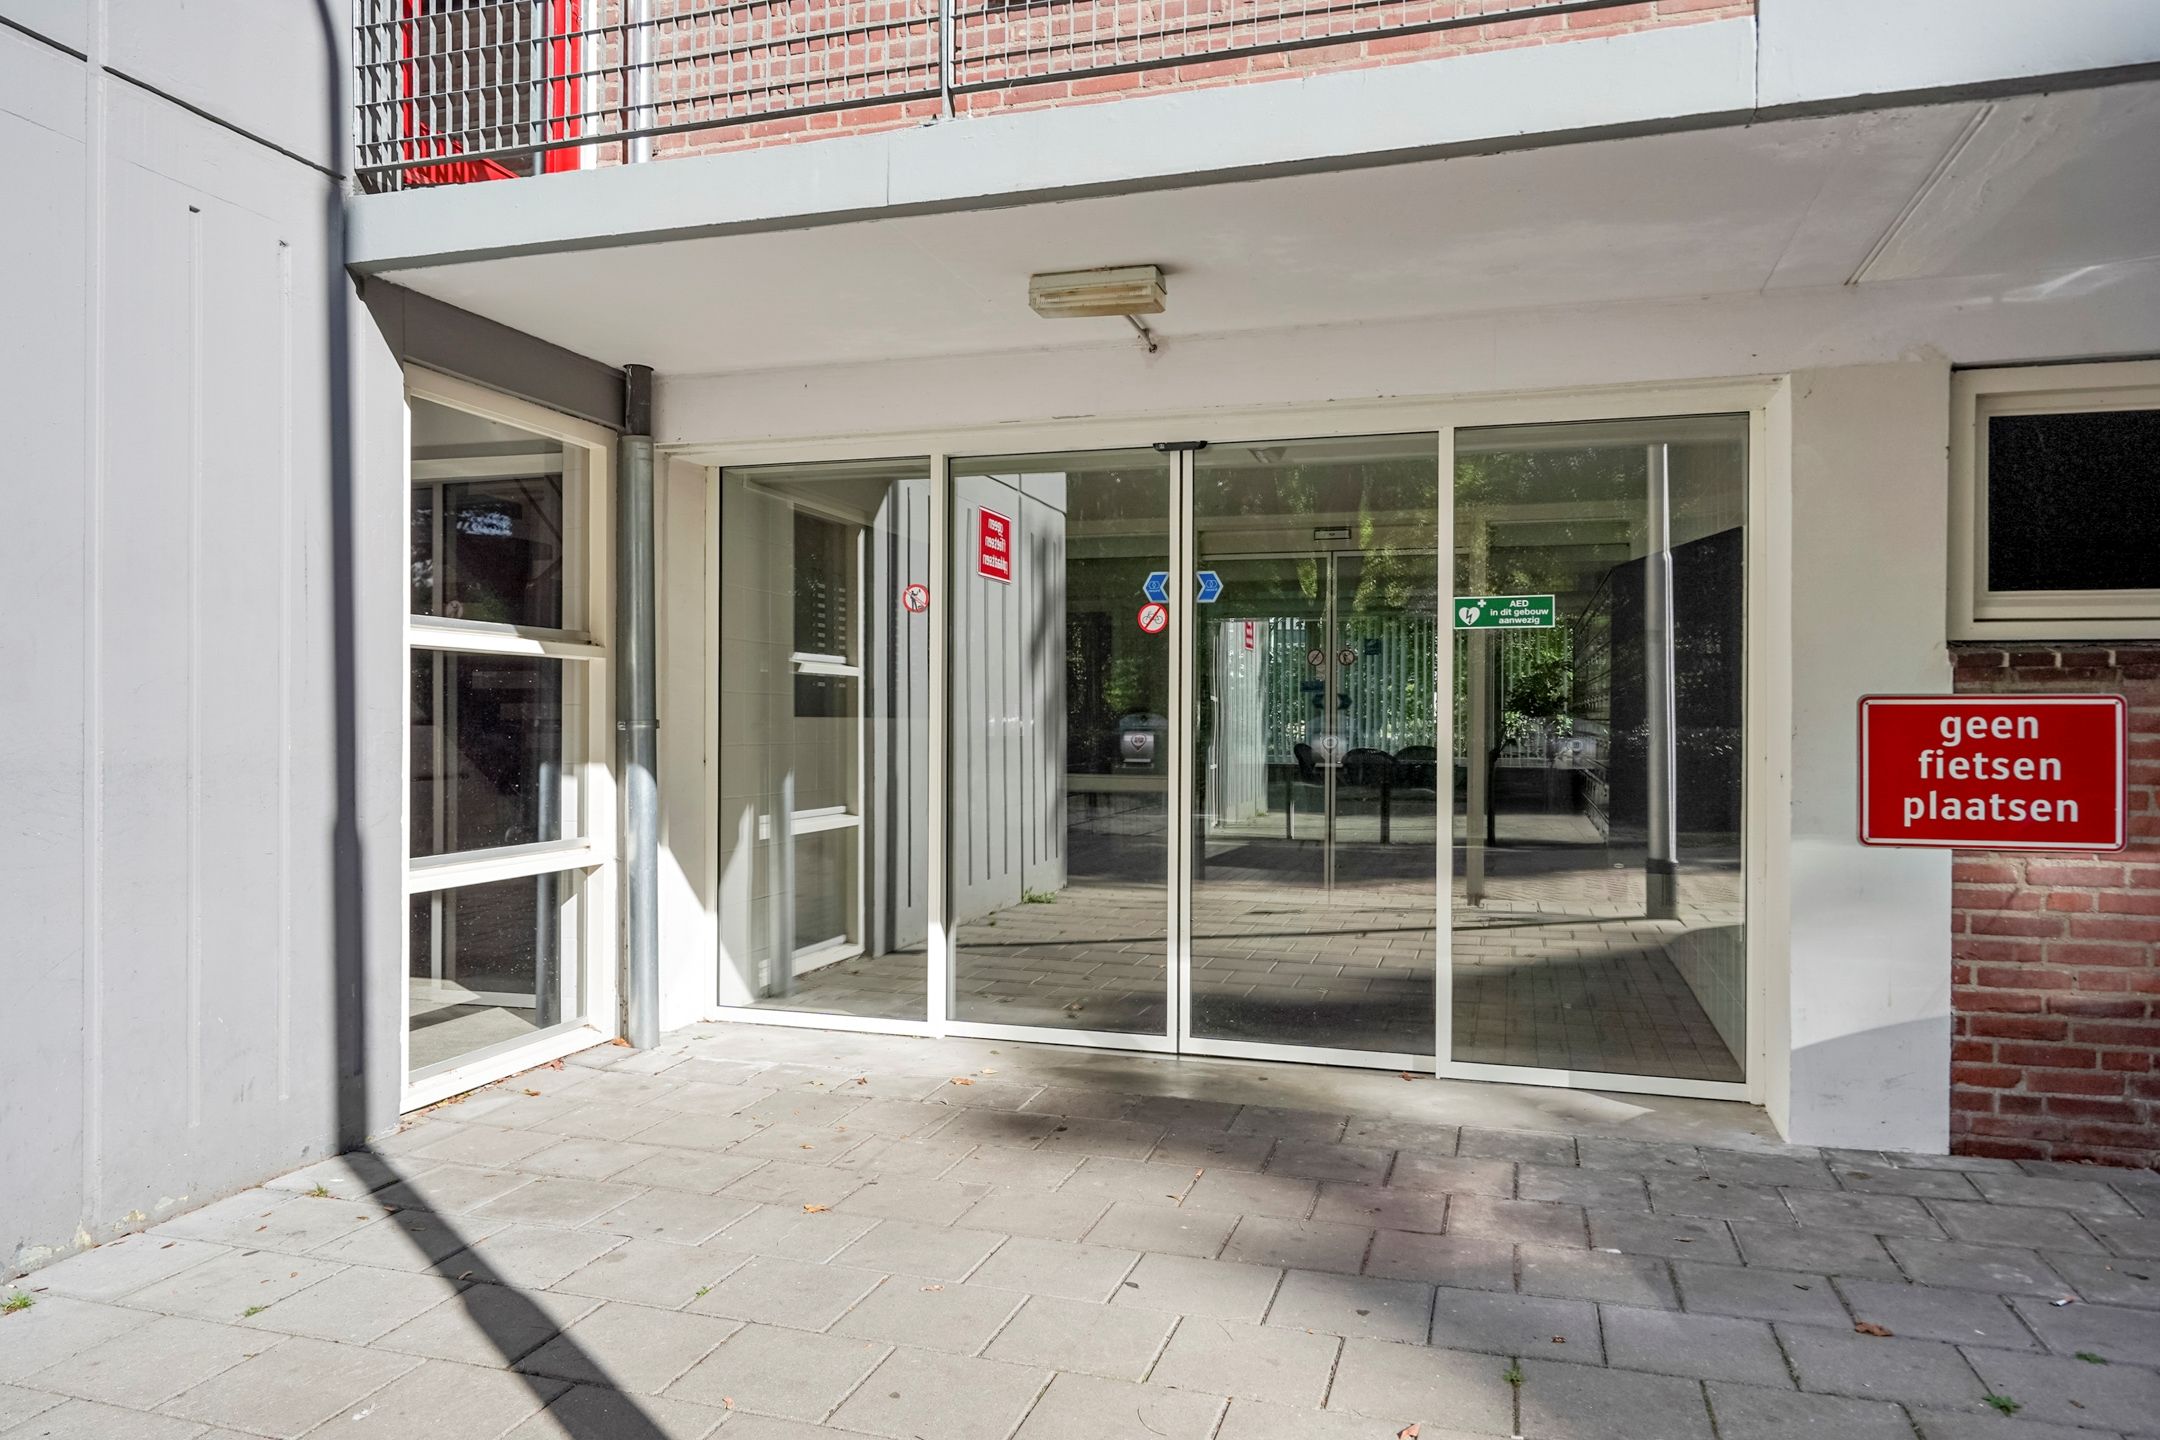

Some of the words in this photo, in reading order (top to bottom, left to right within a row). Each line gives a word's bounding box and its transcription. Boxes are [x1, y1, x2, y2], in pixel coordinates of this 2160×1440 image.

[1501, 608, 1512, 616] dit
[1514, 608, 1549, 617] gebouw
[1510, 600, 1529, 608] AED
[1499, 616, 1540, 624] aanwezig
[1940, 716, 2039, 747] geen
[1918, 749, 2062, 781] fietsen
[1904, 790, 2079, 827] plaatsen
